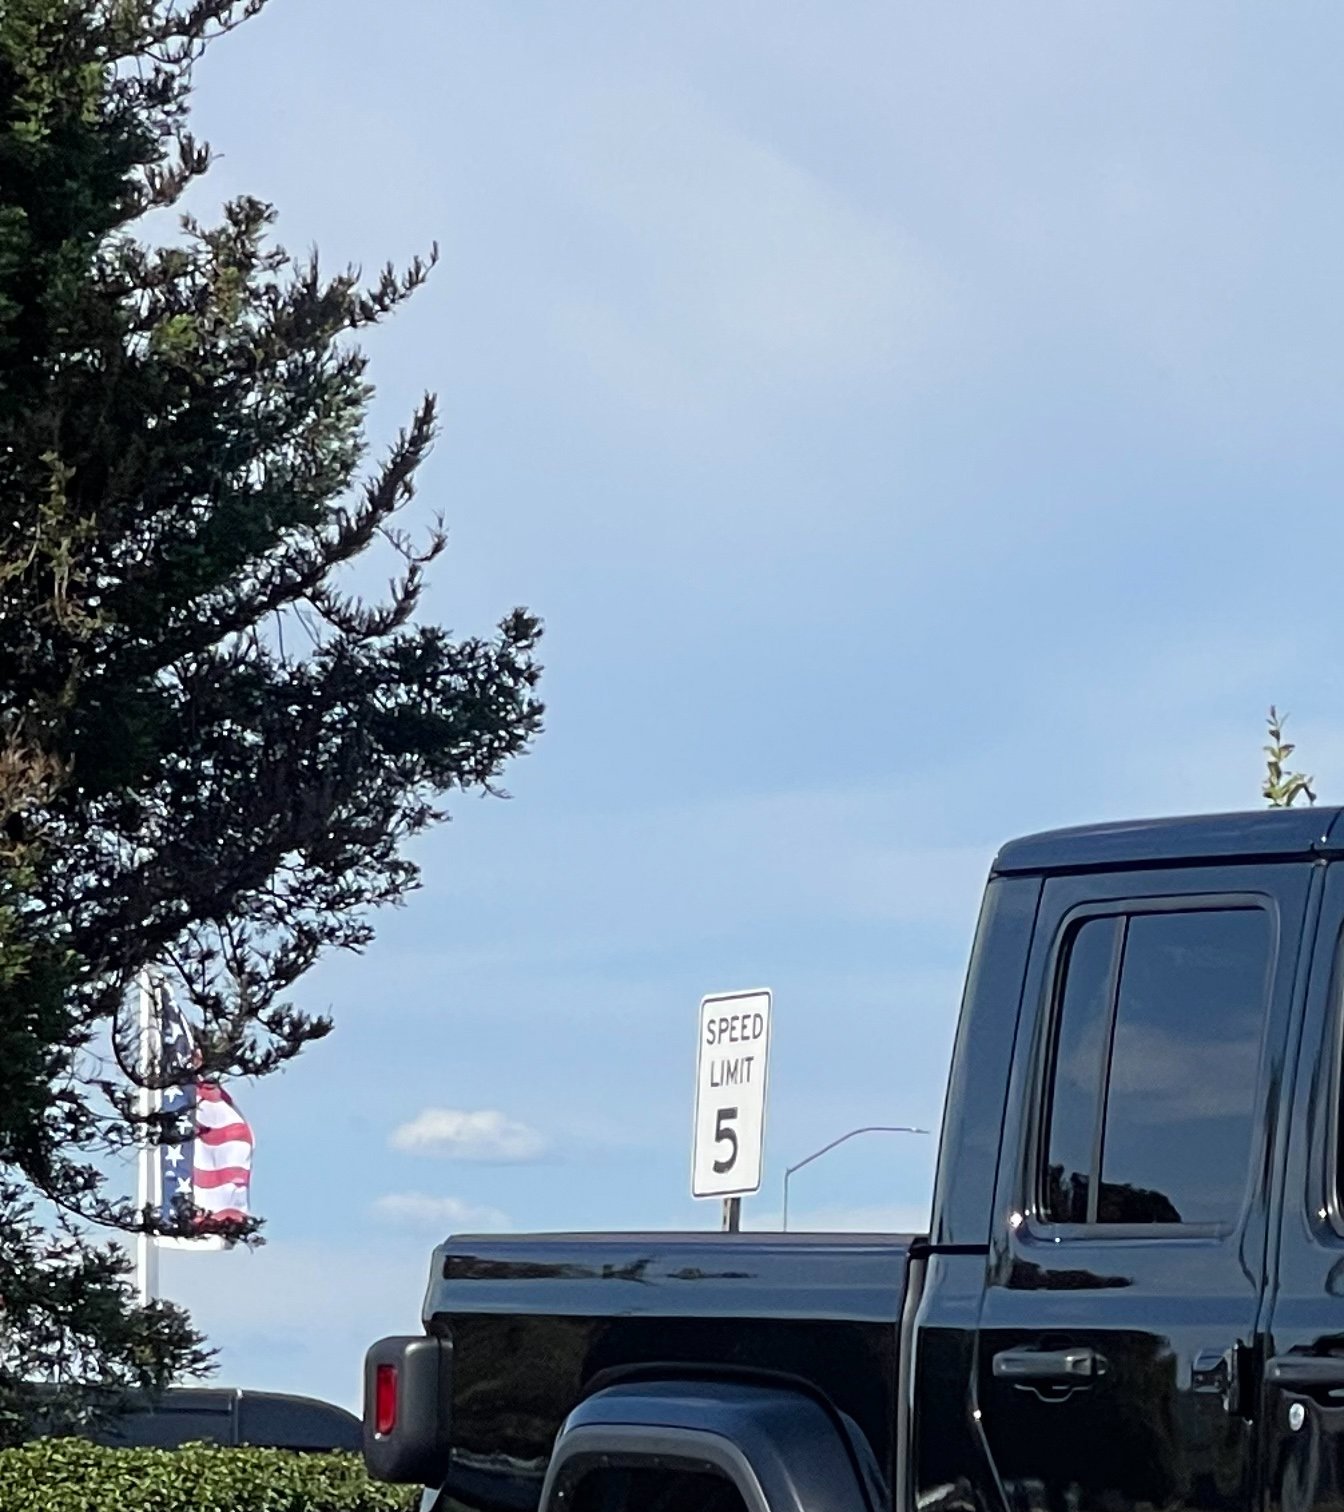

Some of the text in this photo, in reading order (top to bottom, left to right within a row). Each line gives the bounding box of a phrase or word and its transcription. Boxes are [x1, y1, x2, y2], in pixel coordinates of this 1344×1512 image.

[706, 1013, 763, 1045] SPEED
[710, 1056, 755, 1087] LIMIT
[712, 1107, 738, 1174] 5
